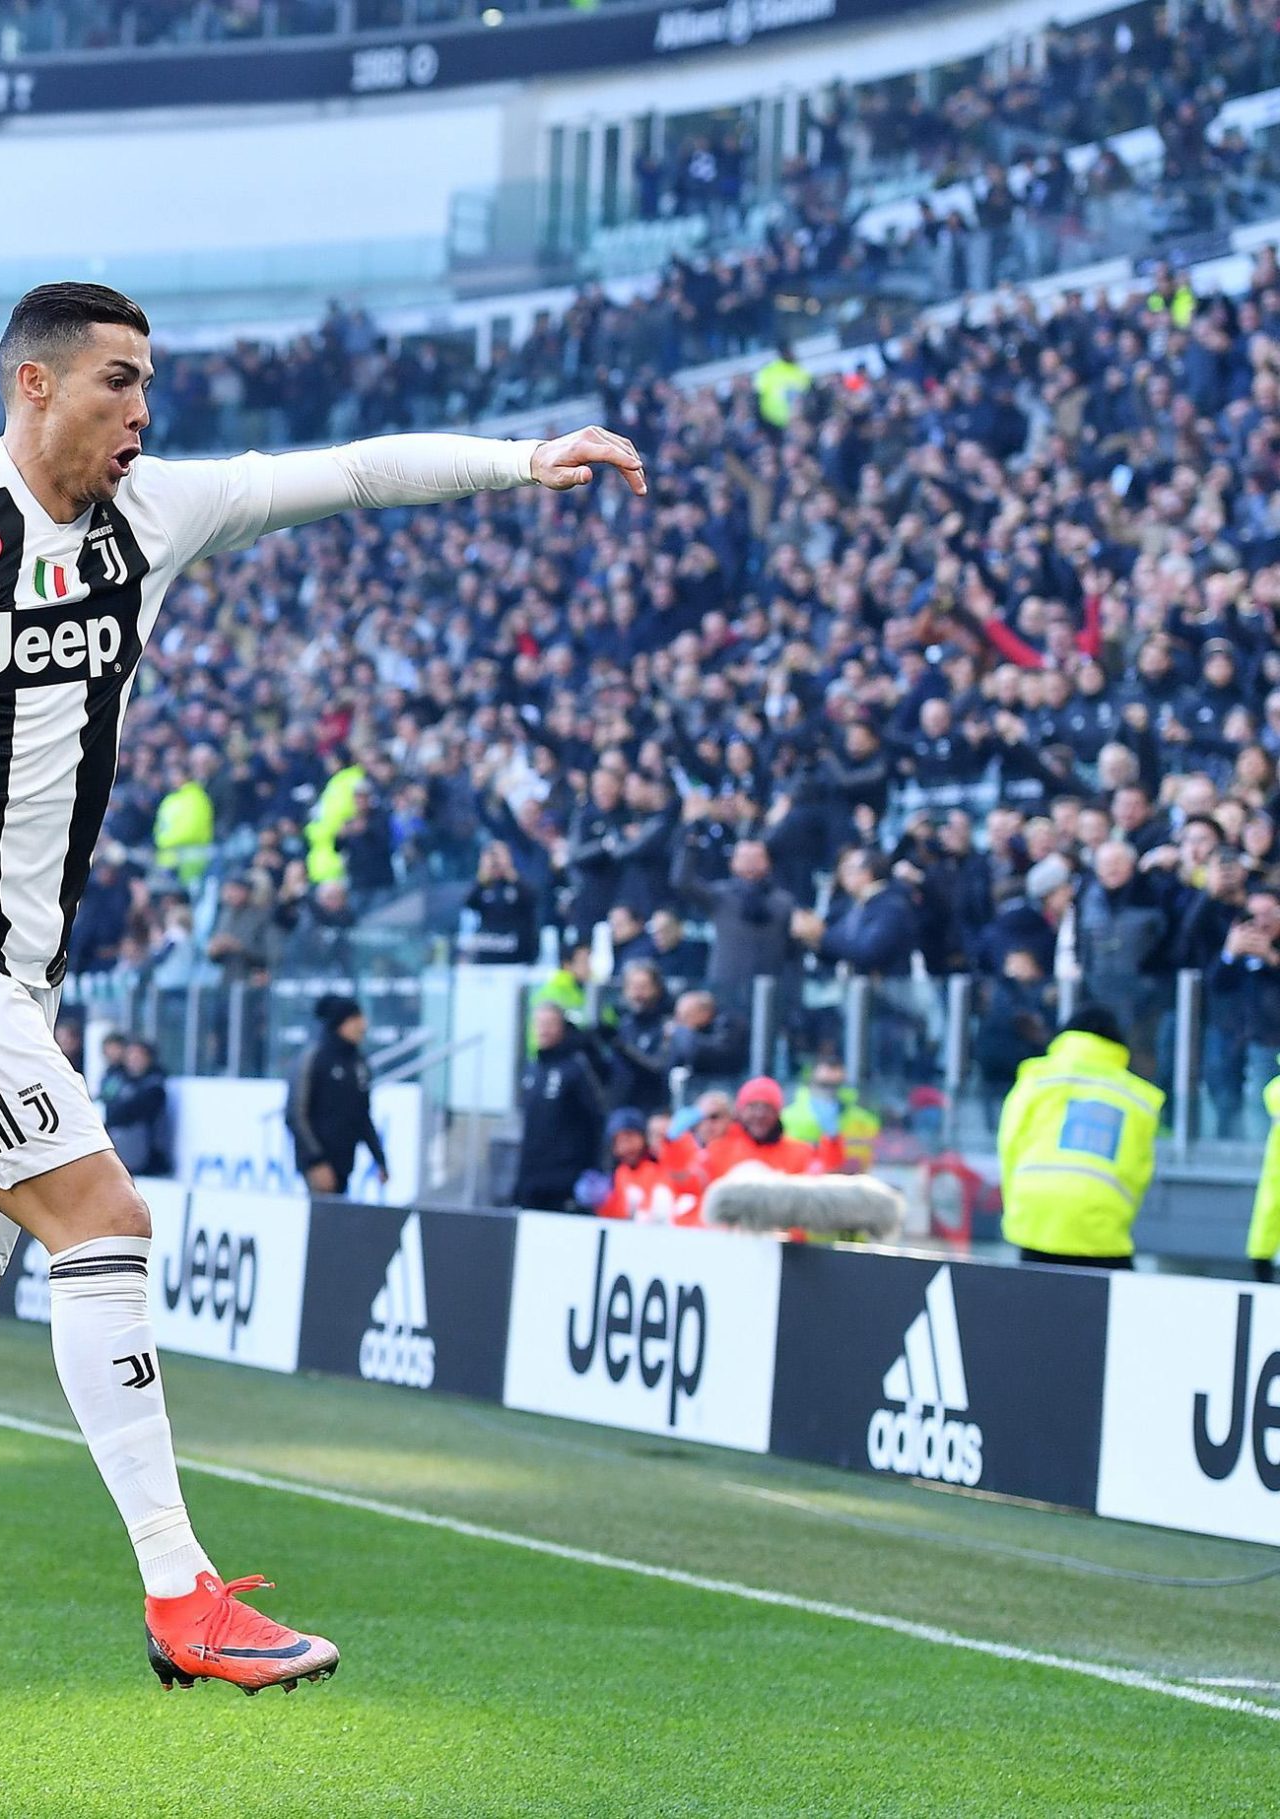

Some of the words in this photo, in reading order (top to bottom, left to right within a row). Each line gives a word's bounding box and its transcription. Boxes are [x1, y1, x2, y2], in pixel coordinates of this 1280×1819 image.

[163, 1192, 256, 1351] Jeep
[568, 1229, 706, 1426] Jeep
[359, 1324, 436, 1389] adidas
[867, 1405, 983, 1487] adidas
